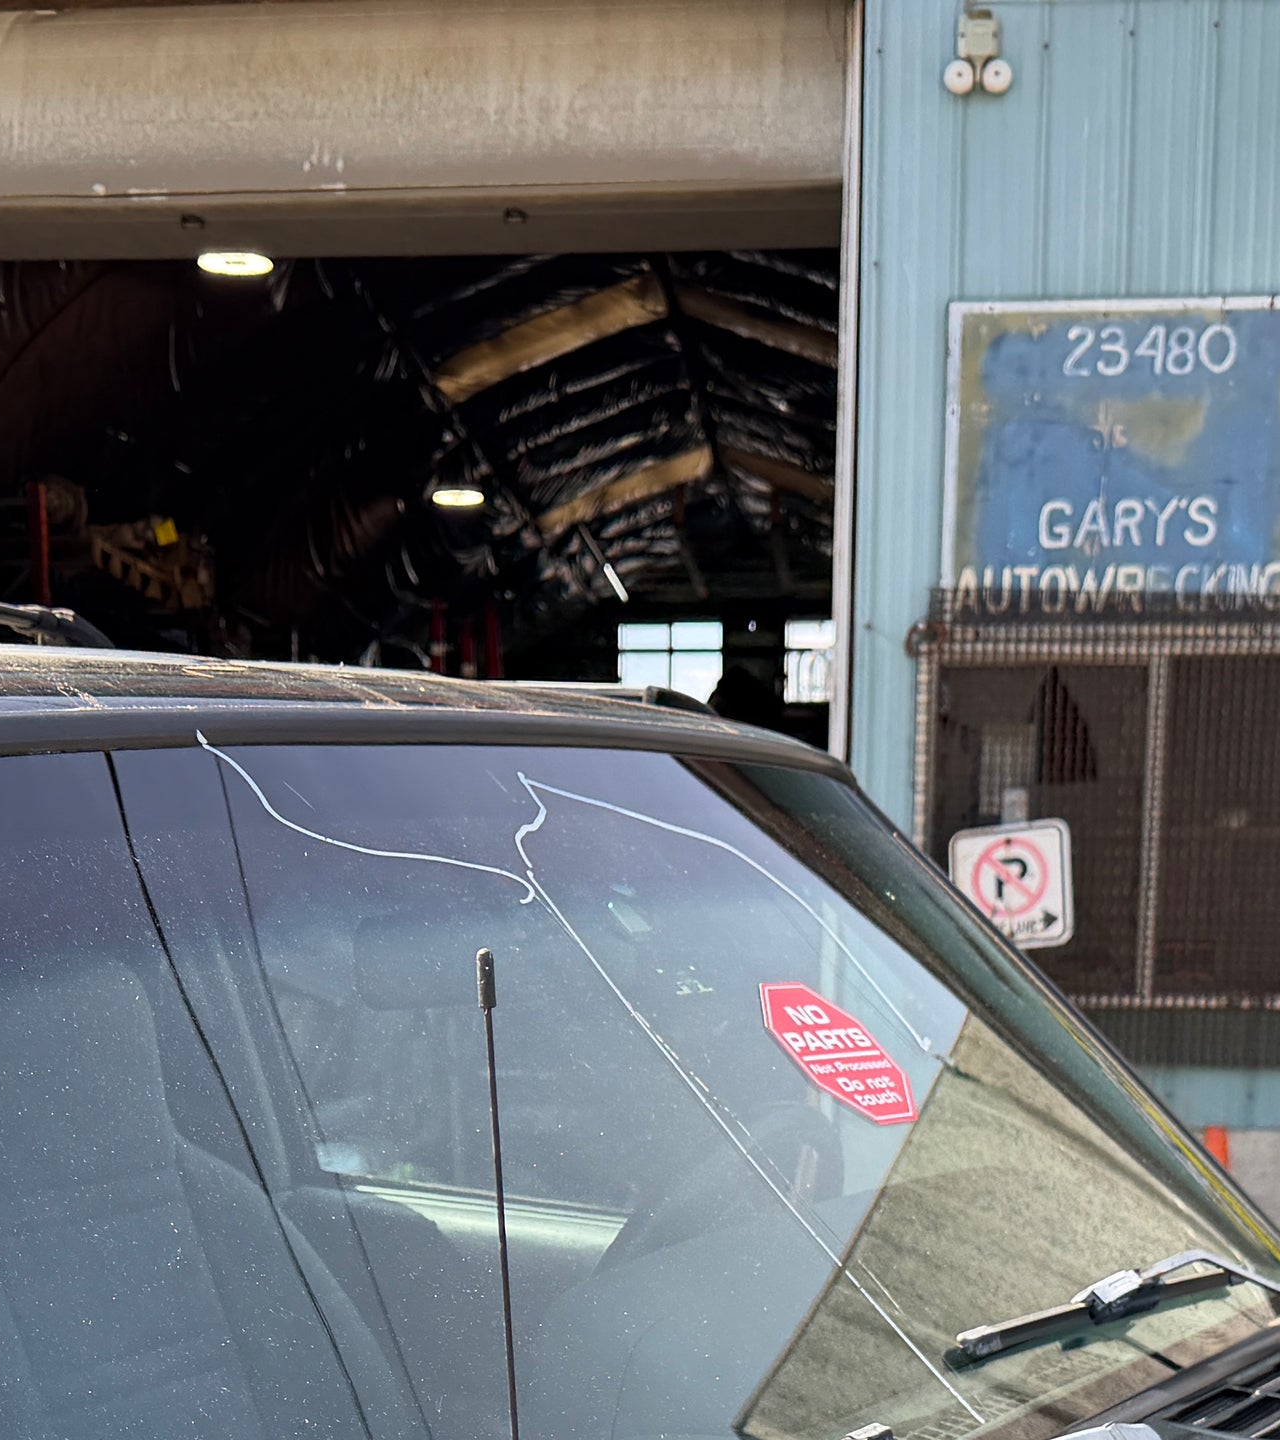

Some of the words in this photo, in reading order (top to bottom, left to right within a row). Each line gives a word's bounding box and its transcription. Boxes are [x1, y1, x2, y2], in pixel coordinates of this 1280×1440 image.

[1063, 323, 1237, 378] 23480
[1038, 496, 1218, 550] GARY'S
[784, 1005, 830, 1026] NO
[782, 1027, 871, 1053] PARTS
[810, 1062, 834, 1075] Not
[836, 1077, 865, 1093] Do
[865, 1075, 895, 1090] not
[854, 1089, 903, 1107] touch
